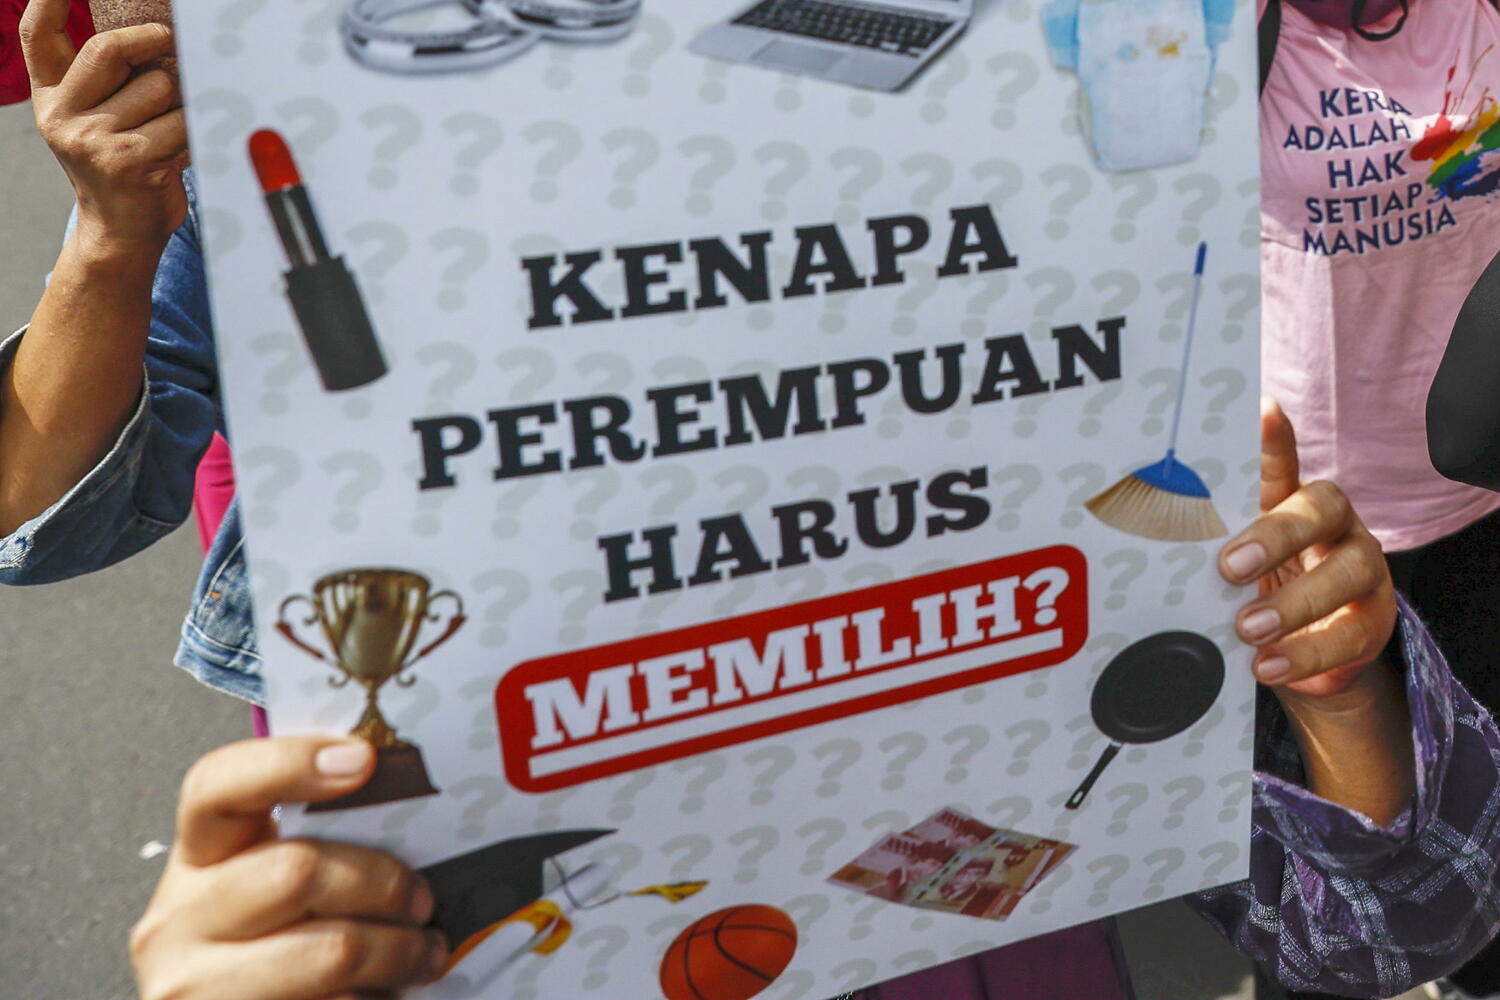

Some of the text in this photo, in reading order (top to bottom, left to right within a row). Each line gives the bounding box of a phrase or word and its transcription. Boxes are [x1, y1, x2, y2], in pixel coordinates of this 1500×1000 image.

[1283, 118, 1411, 151] ADALAH
[1328, 149, 1407, 189] HAK
[1303, 203, 1457, 257] MANUSIA
[1305, 182, 1423, 225] SETIAP
[520, 203, 1019, 331] KENAPA
[411, 315, 1127, 491] PEREMPUAN
[598, 465, 992, 603] HARUS
[524, 566, 1070, 750] MEMILIH?
